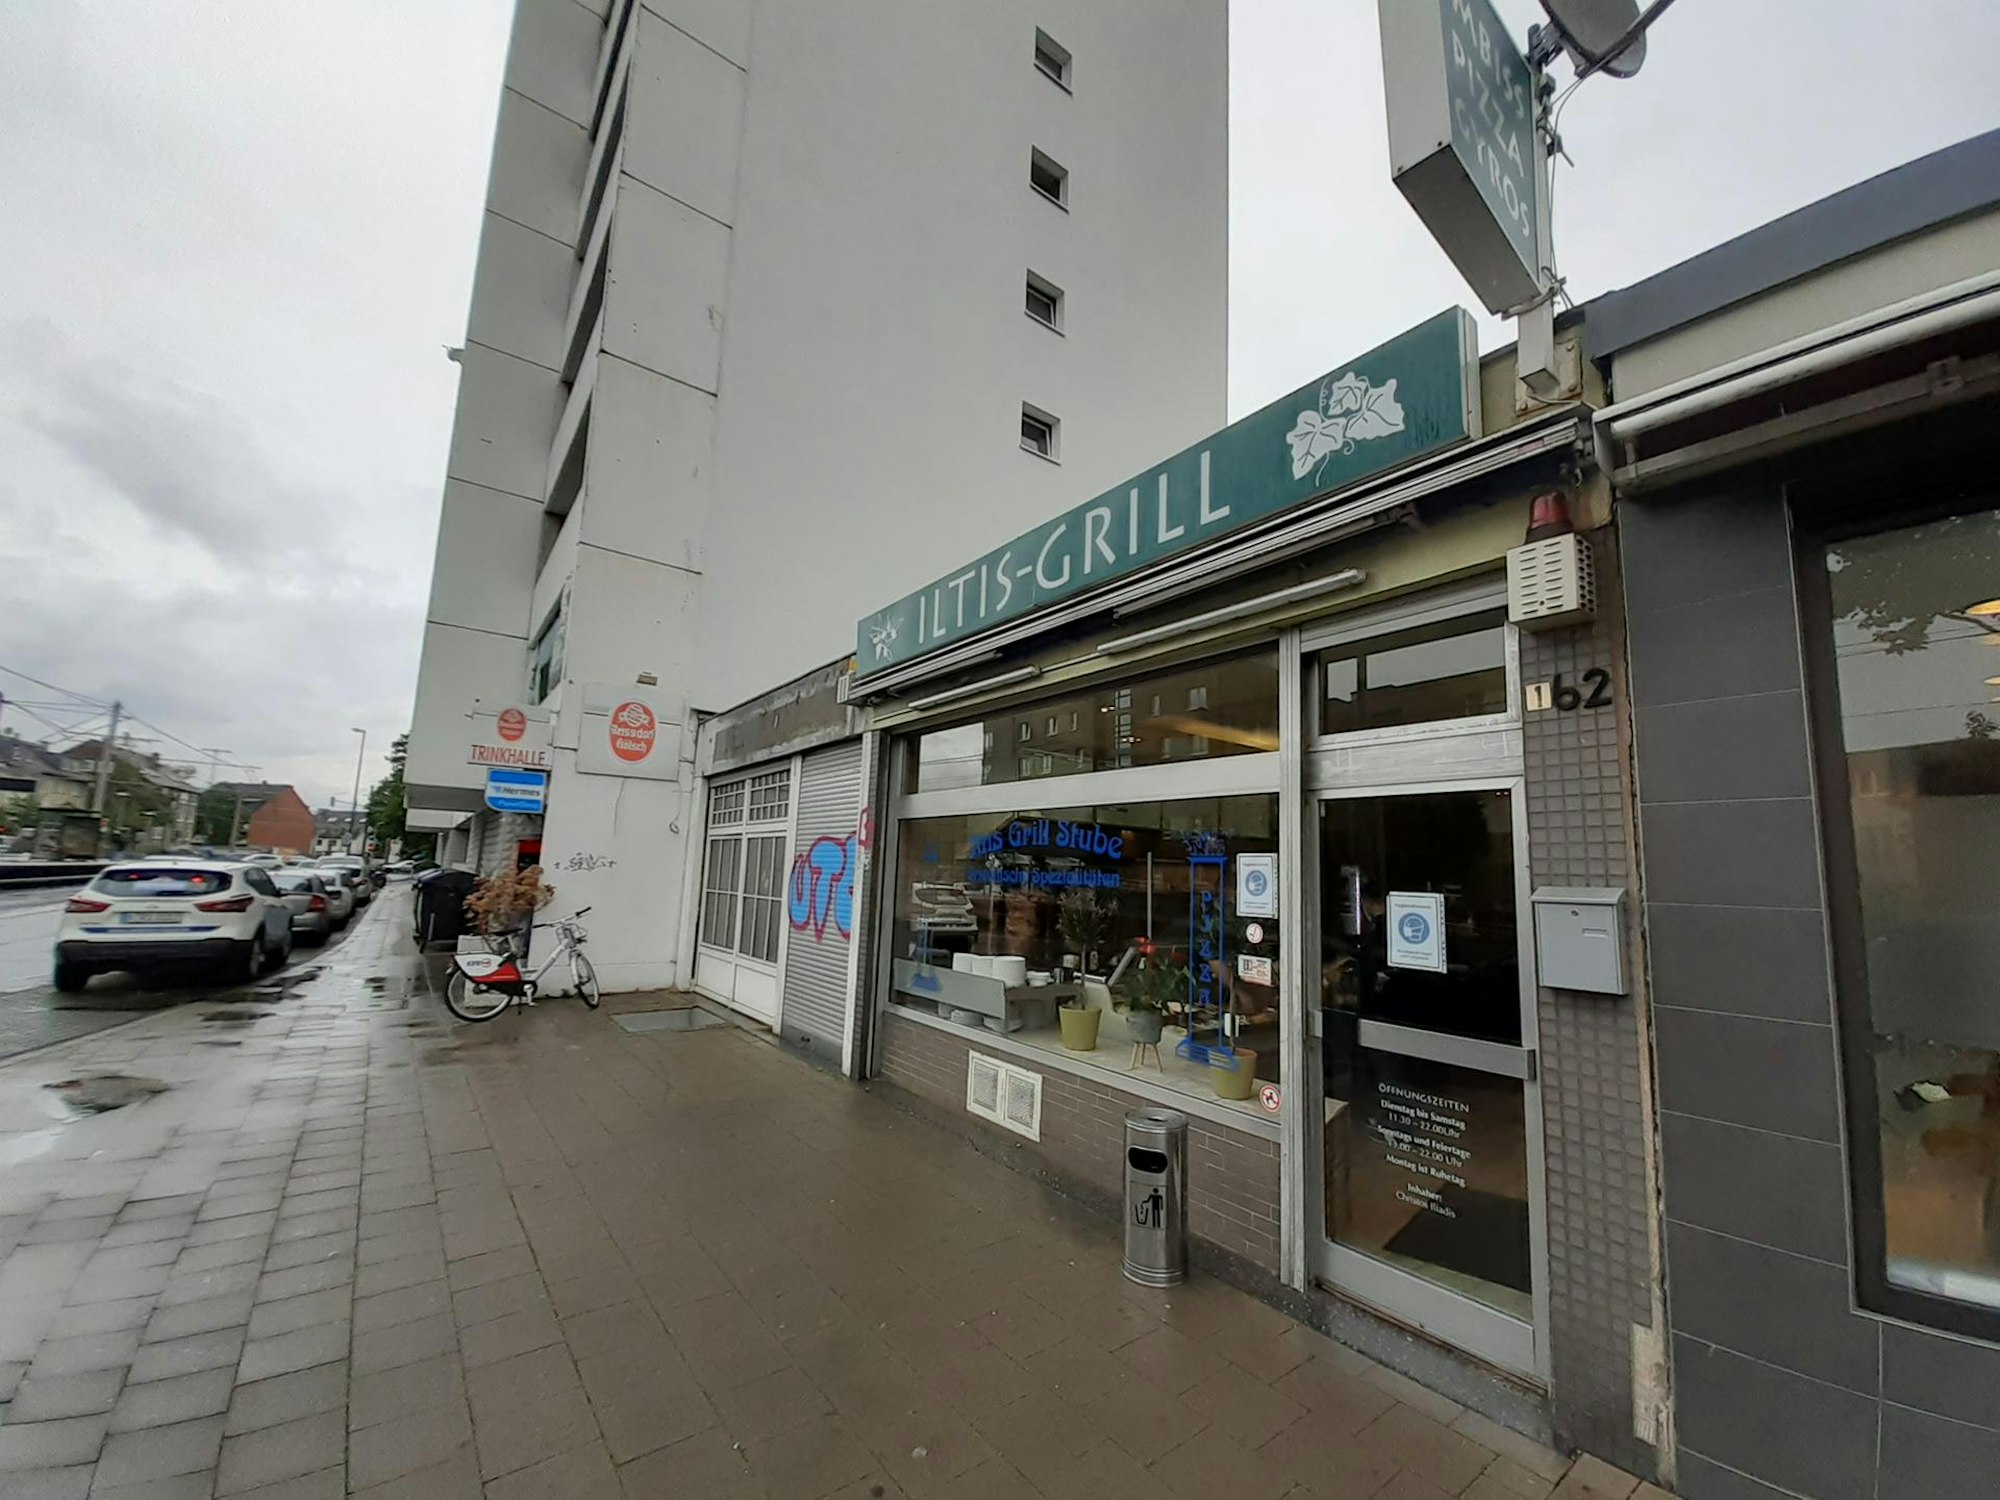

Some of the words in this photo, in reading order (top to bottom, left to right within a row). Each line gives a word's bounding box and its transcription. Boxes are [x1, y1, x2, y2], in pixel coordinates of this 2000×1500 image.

[1453, 0, 1524, 120] MBISS
[1452, 30, 1524, 178] PIZZA
[1455, 98, 1530, 238] GYROS
[918, 450, 1230, 644] ILTIS-GRILL
[471, 744, 546, 767] TRINKHALLE
[501, 787, 541, 796] Hermes
[1008, 819, 1049, 848] Grill
[1056, 820, 1123, 860] Stube
[1430, 1111, 1466, 1131] Samstag
[1385, 1154, 1417, 1172] Montag
[1430, 1167, 1466, 1189] Ruhetag
